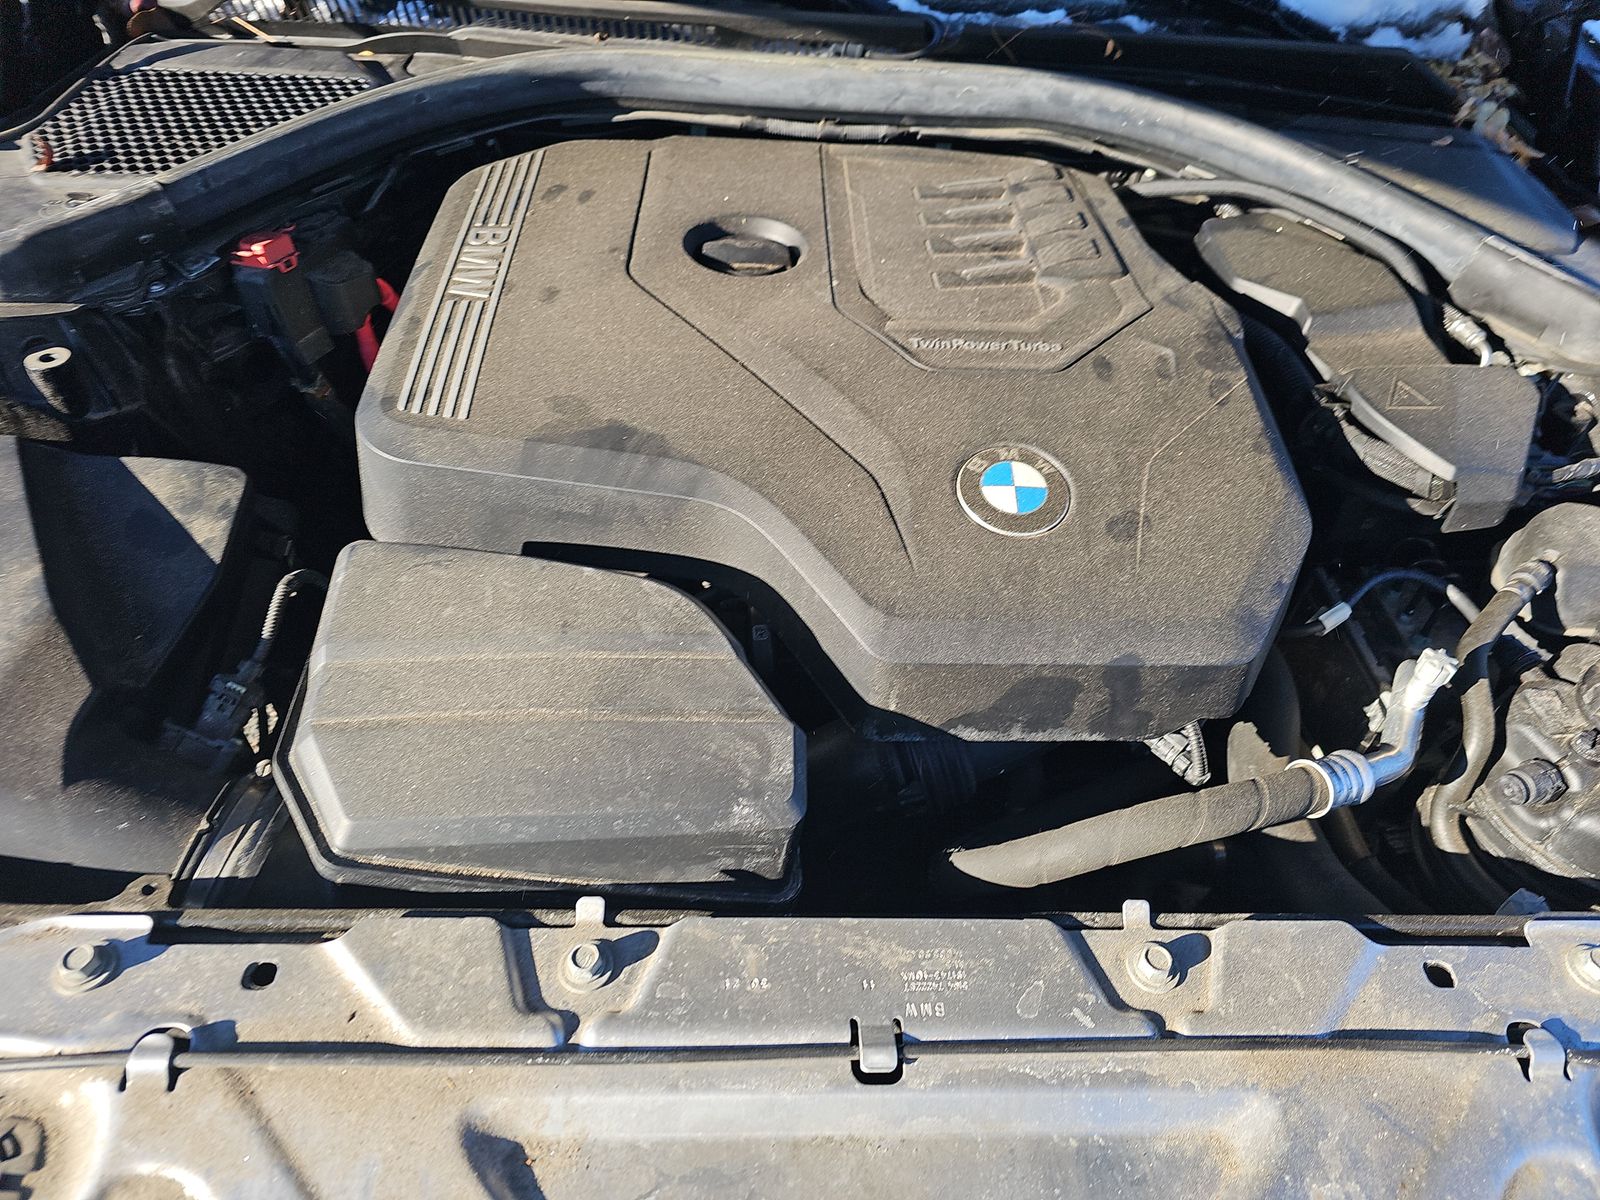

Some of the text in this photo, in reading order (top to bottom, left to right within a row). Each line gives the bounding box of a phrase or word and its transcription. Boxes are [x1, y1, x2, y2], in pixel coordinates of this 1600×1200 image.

[445, 226, 513, 299] BMW
[966, 447, 1057, 474] BMW
[905, 1002, 946, 1018] BMW
